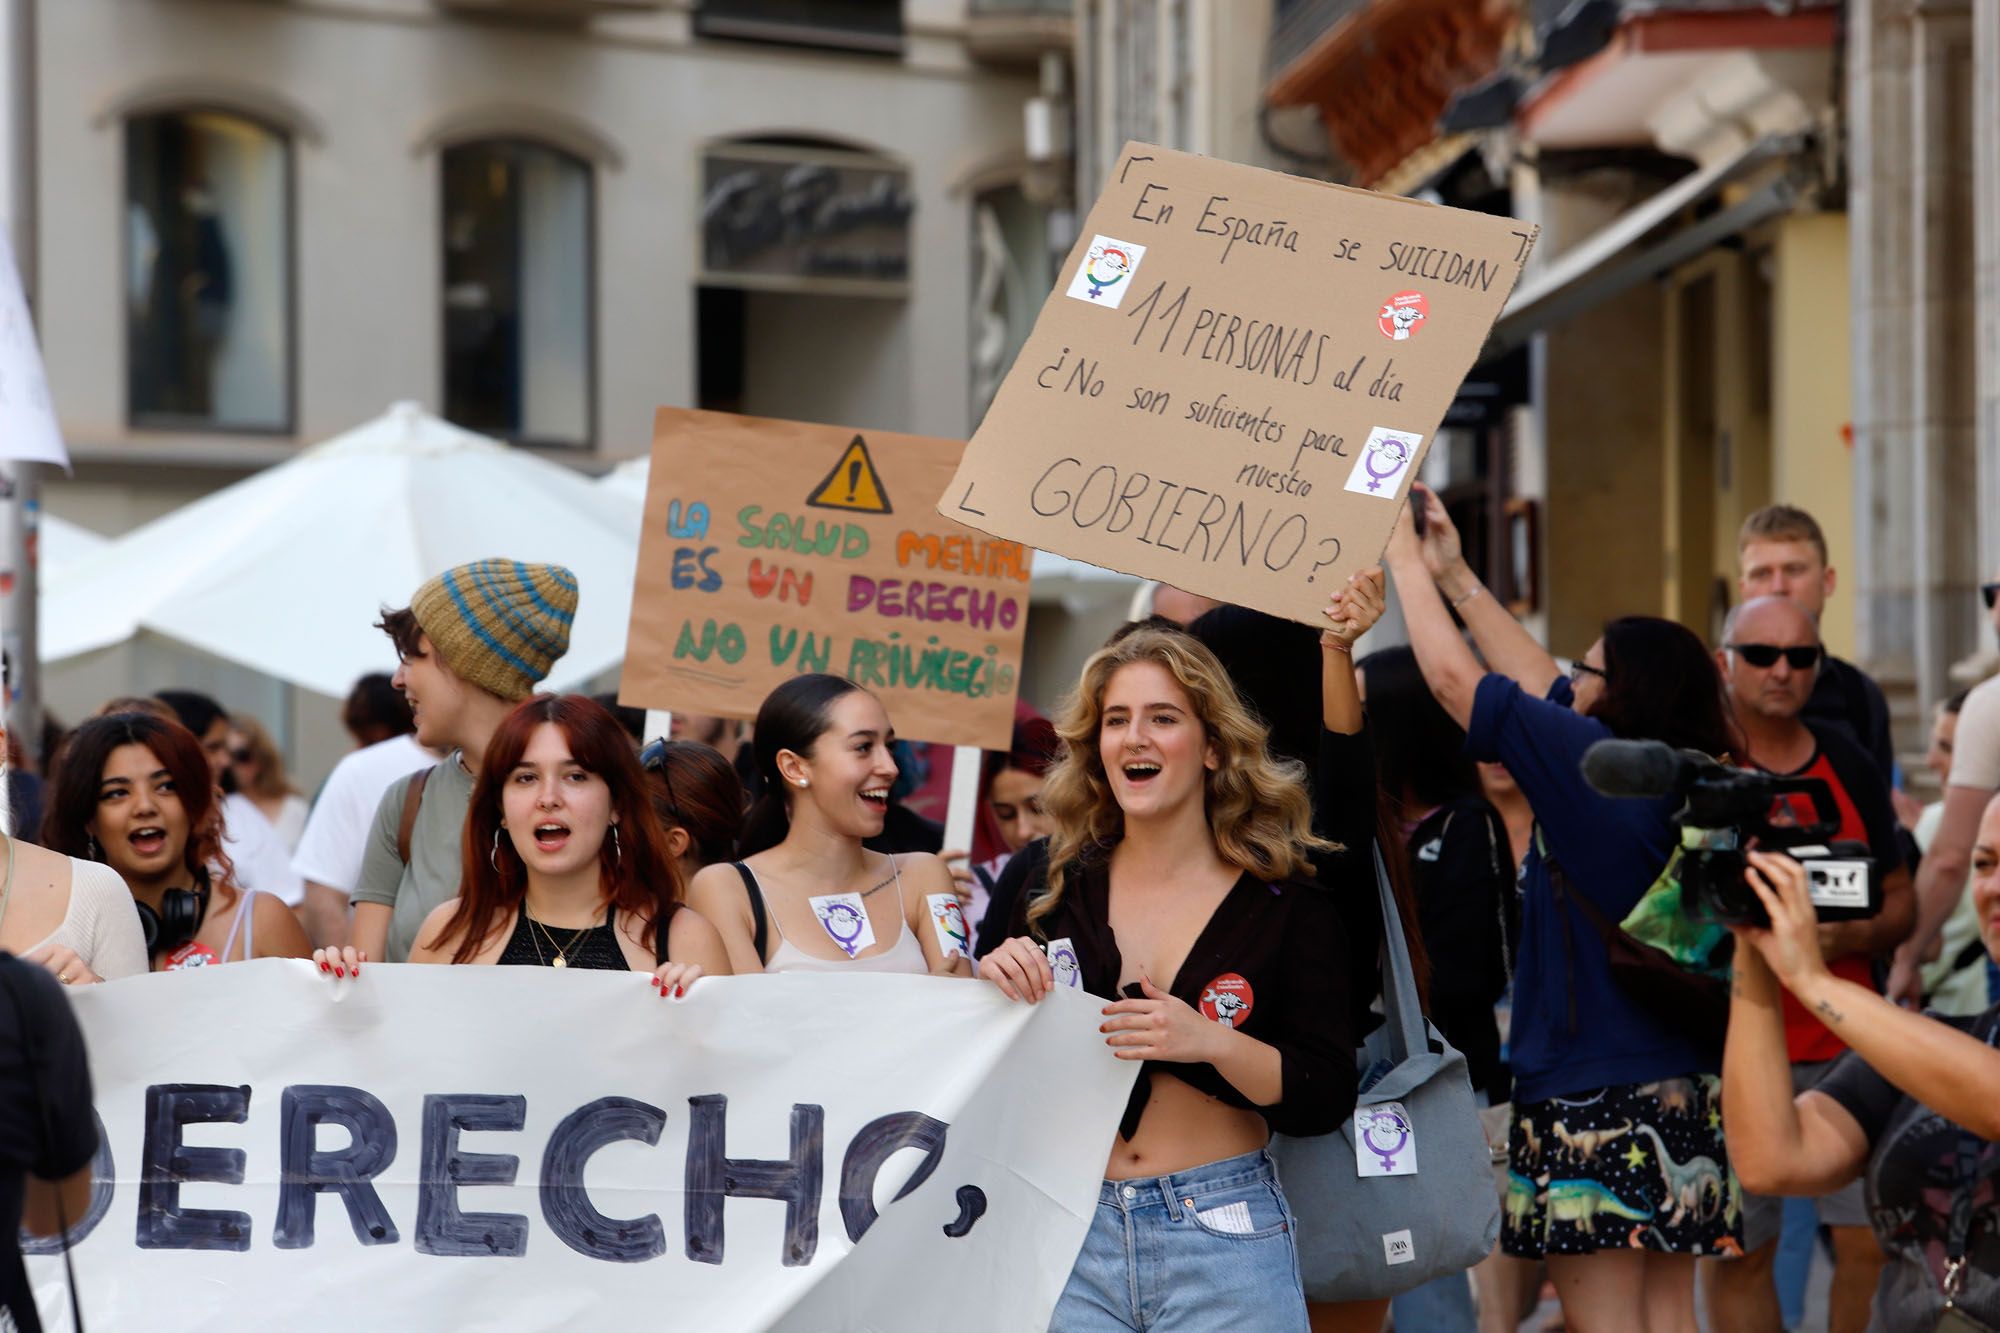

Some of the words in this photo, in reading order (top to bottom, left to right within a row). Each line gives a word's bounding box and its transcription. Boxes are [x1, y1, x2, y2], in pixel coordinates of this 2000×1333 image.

[1132, 183, 1174, 225] En
[1195, 196, 1300, 264] España
[1333, 238, 1362, 262] se
[1379, 241, 1499, 292] SUICIDAN
[1127, 280, 1191, 353] 11
[1182, 308, 1331, 386] PERSONAS
[1333, 355, 1367, 393] al
[1126, 386, 1170, 416] son
[1184, 393, 1286, 444] suficientes
[1290, 427, 1349, 472] para
[1030, 457, 1342, 584] GOBIERNO?
[1235, 462, 1313, 498] nuestro
[667, 499, 710, 541] LA
[736, 505, 870, 559] SALUD
[896, 529, 1031, 583] MENTAL
[670, 547, 723, 593] ES
[748, 559, 813, 606] UN
[846, 574, 1019, 631] DERECHO
[672, 618, 747, 665] NO
[769, 624, 831, 674] UN
